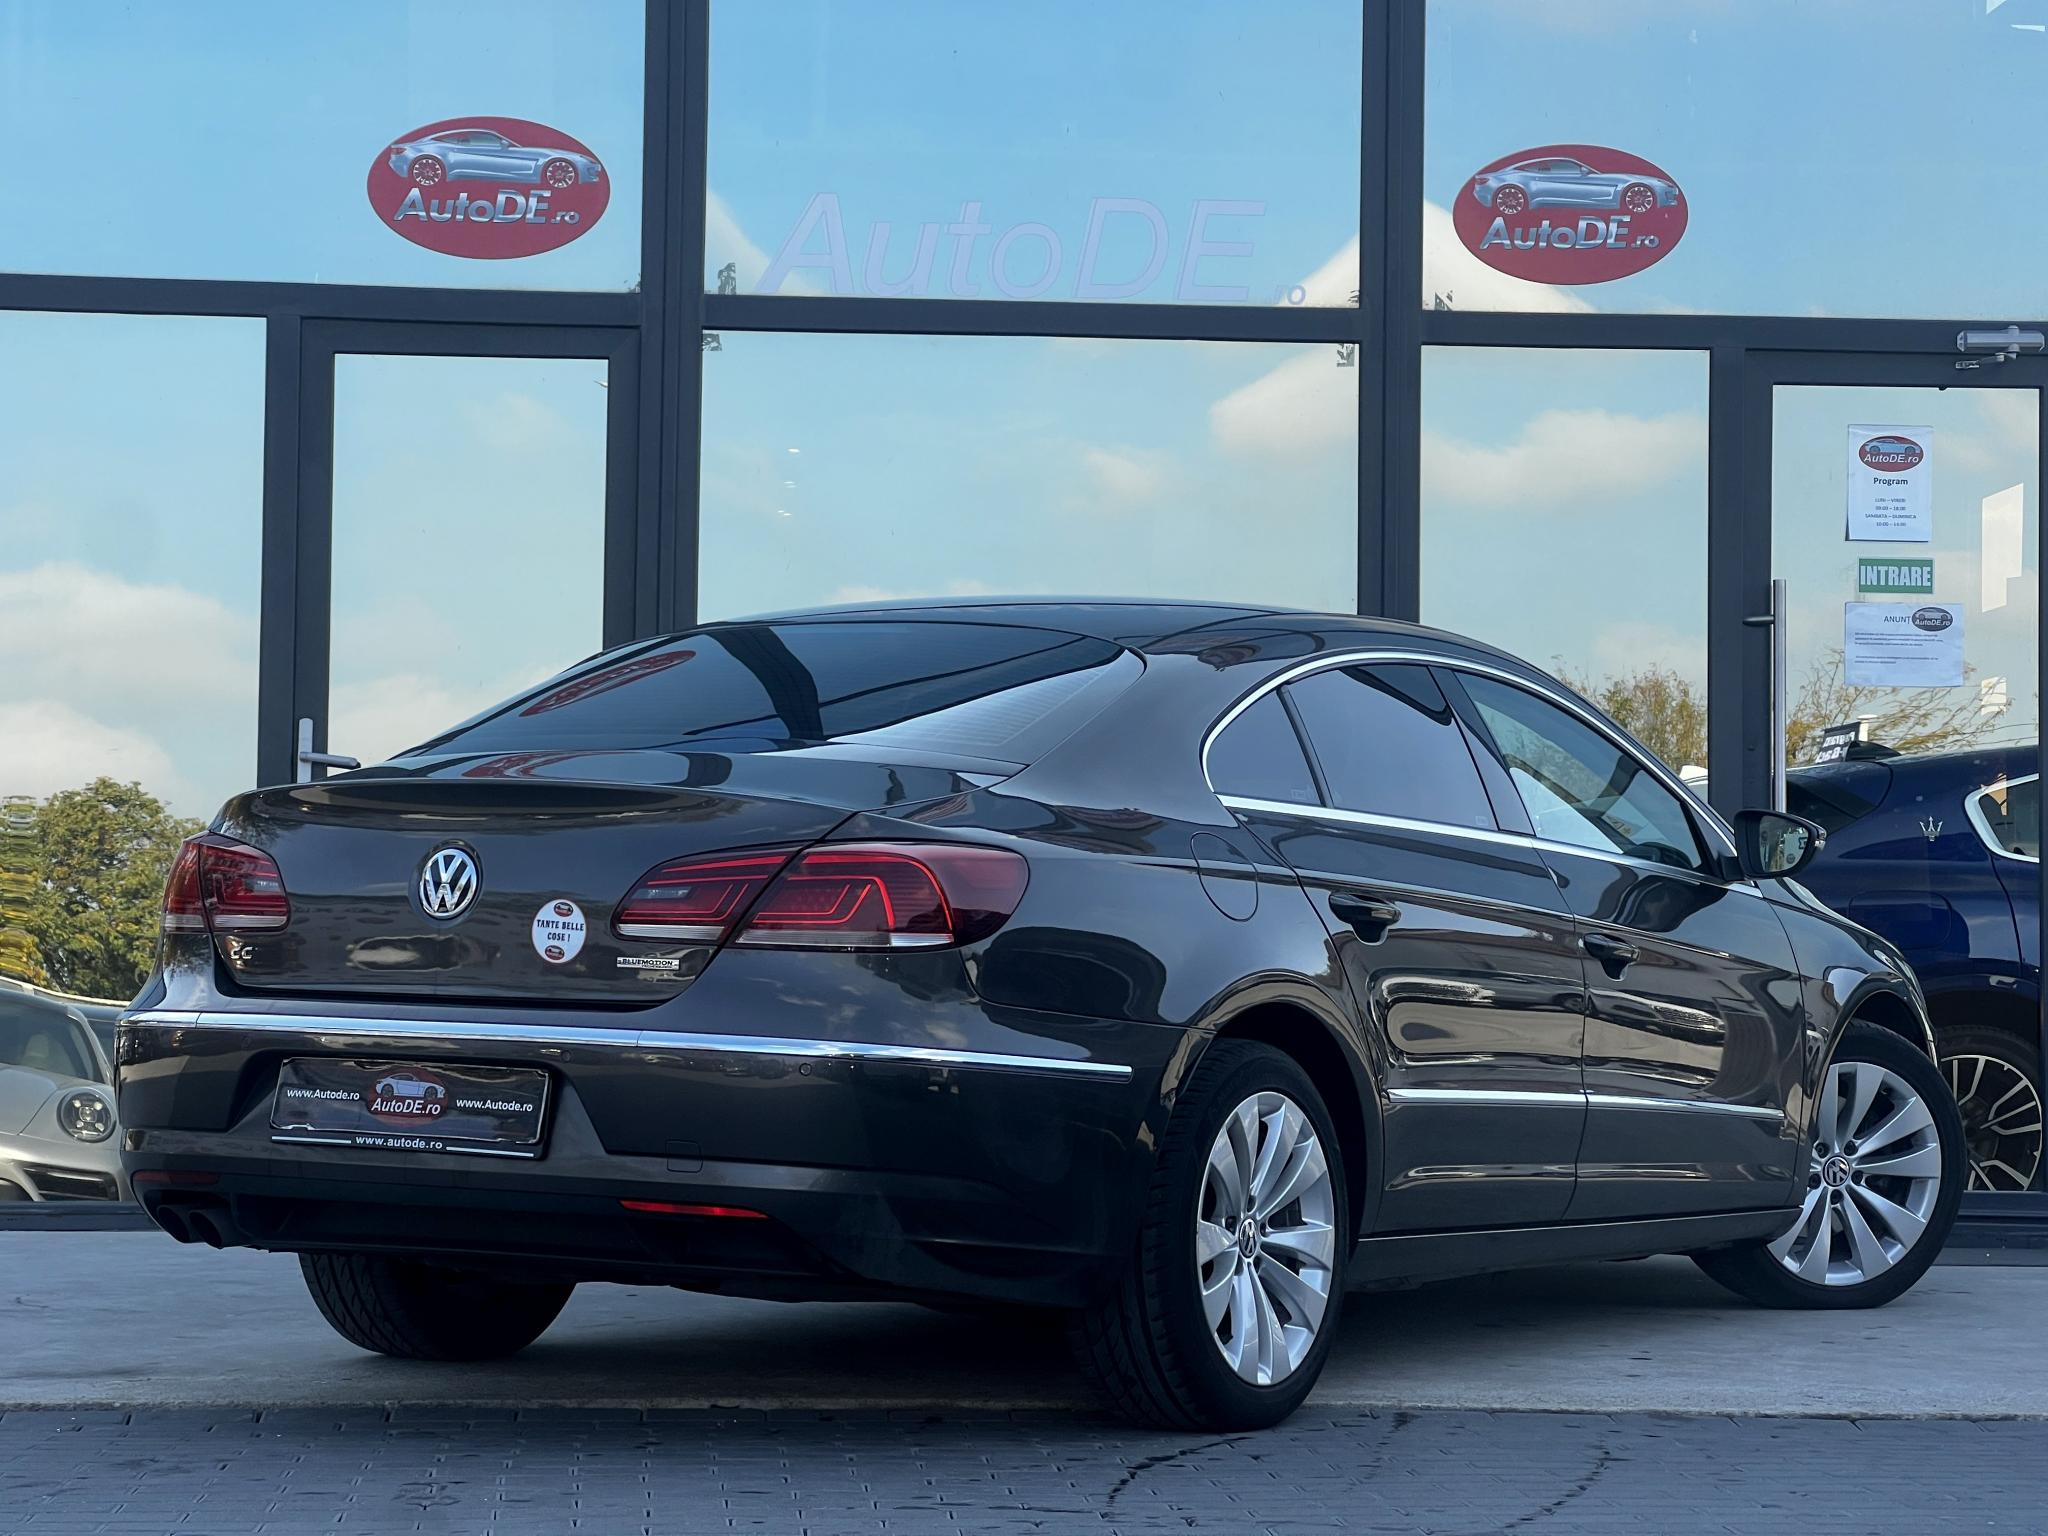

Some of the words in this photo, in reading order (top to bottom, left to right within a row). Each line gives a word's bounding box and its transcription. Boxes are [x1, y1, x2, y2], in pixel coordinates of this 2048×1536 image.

[1863, 453, 1919, 464] AutoDE.ro
[1873, 477, 1909, 486] Program
[1860, 565, 1932, 587] INTRARE
[536, 919, 560, 929] TANTE
[561, 921, 585, 931] BELLE
[547, 932, 566, 941] COSE
[286, 1087, 360, 1101] www.Autode.ro
[371, 1097, 442, 1116] AutoDE.ro
[456, 1098, 534, 1112] www.Autode.ro
[355, 1134, 443, 1150] www.autode.ro
